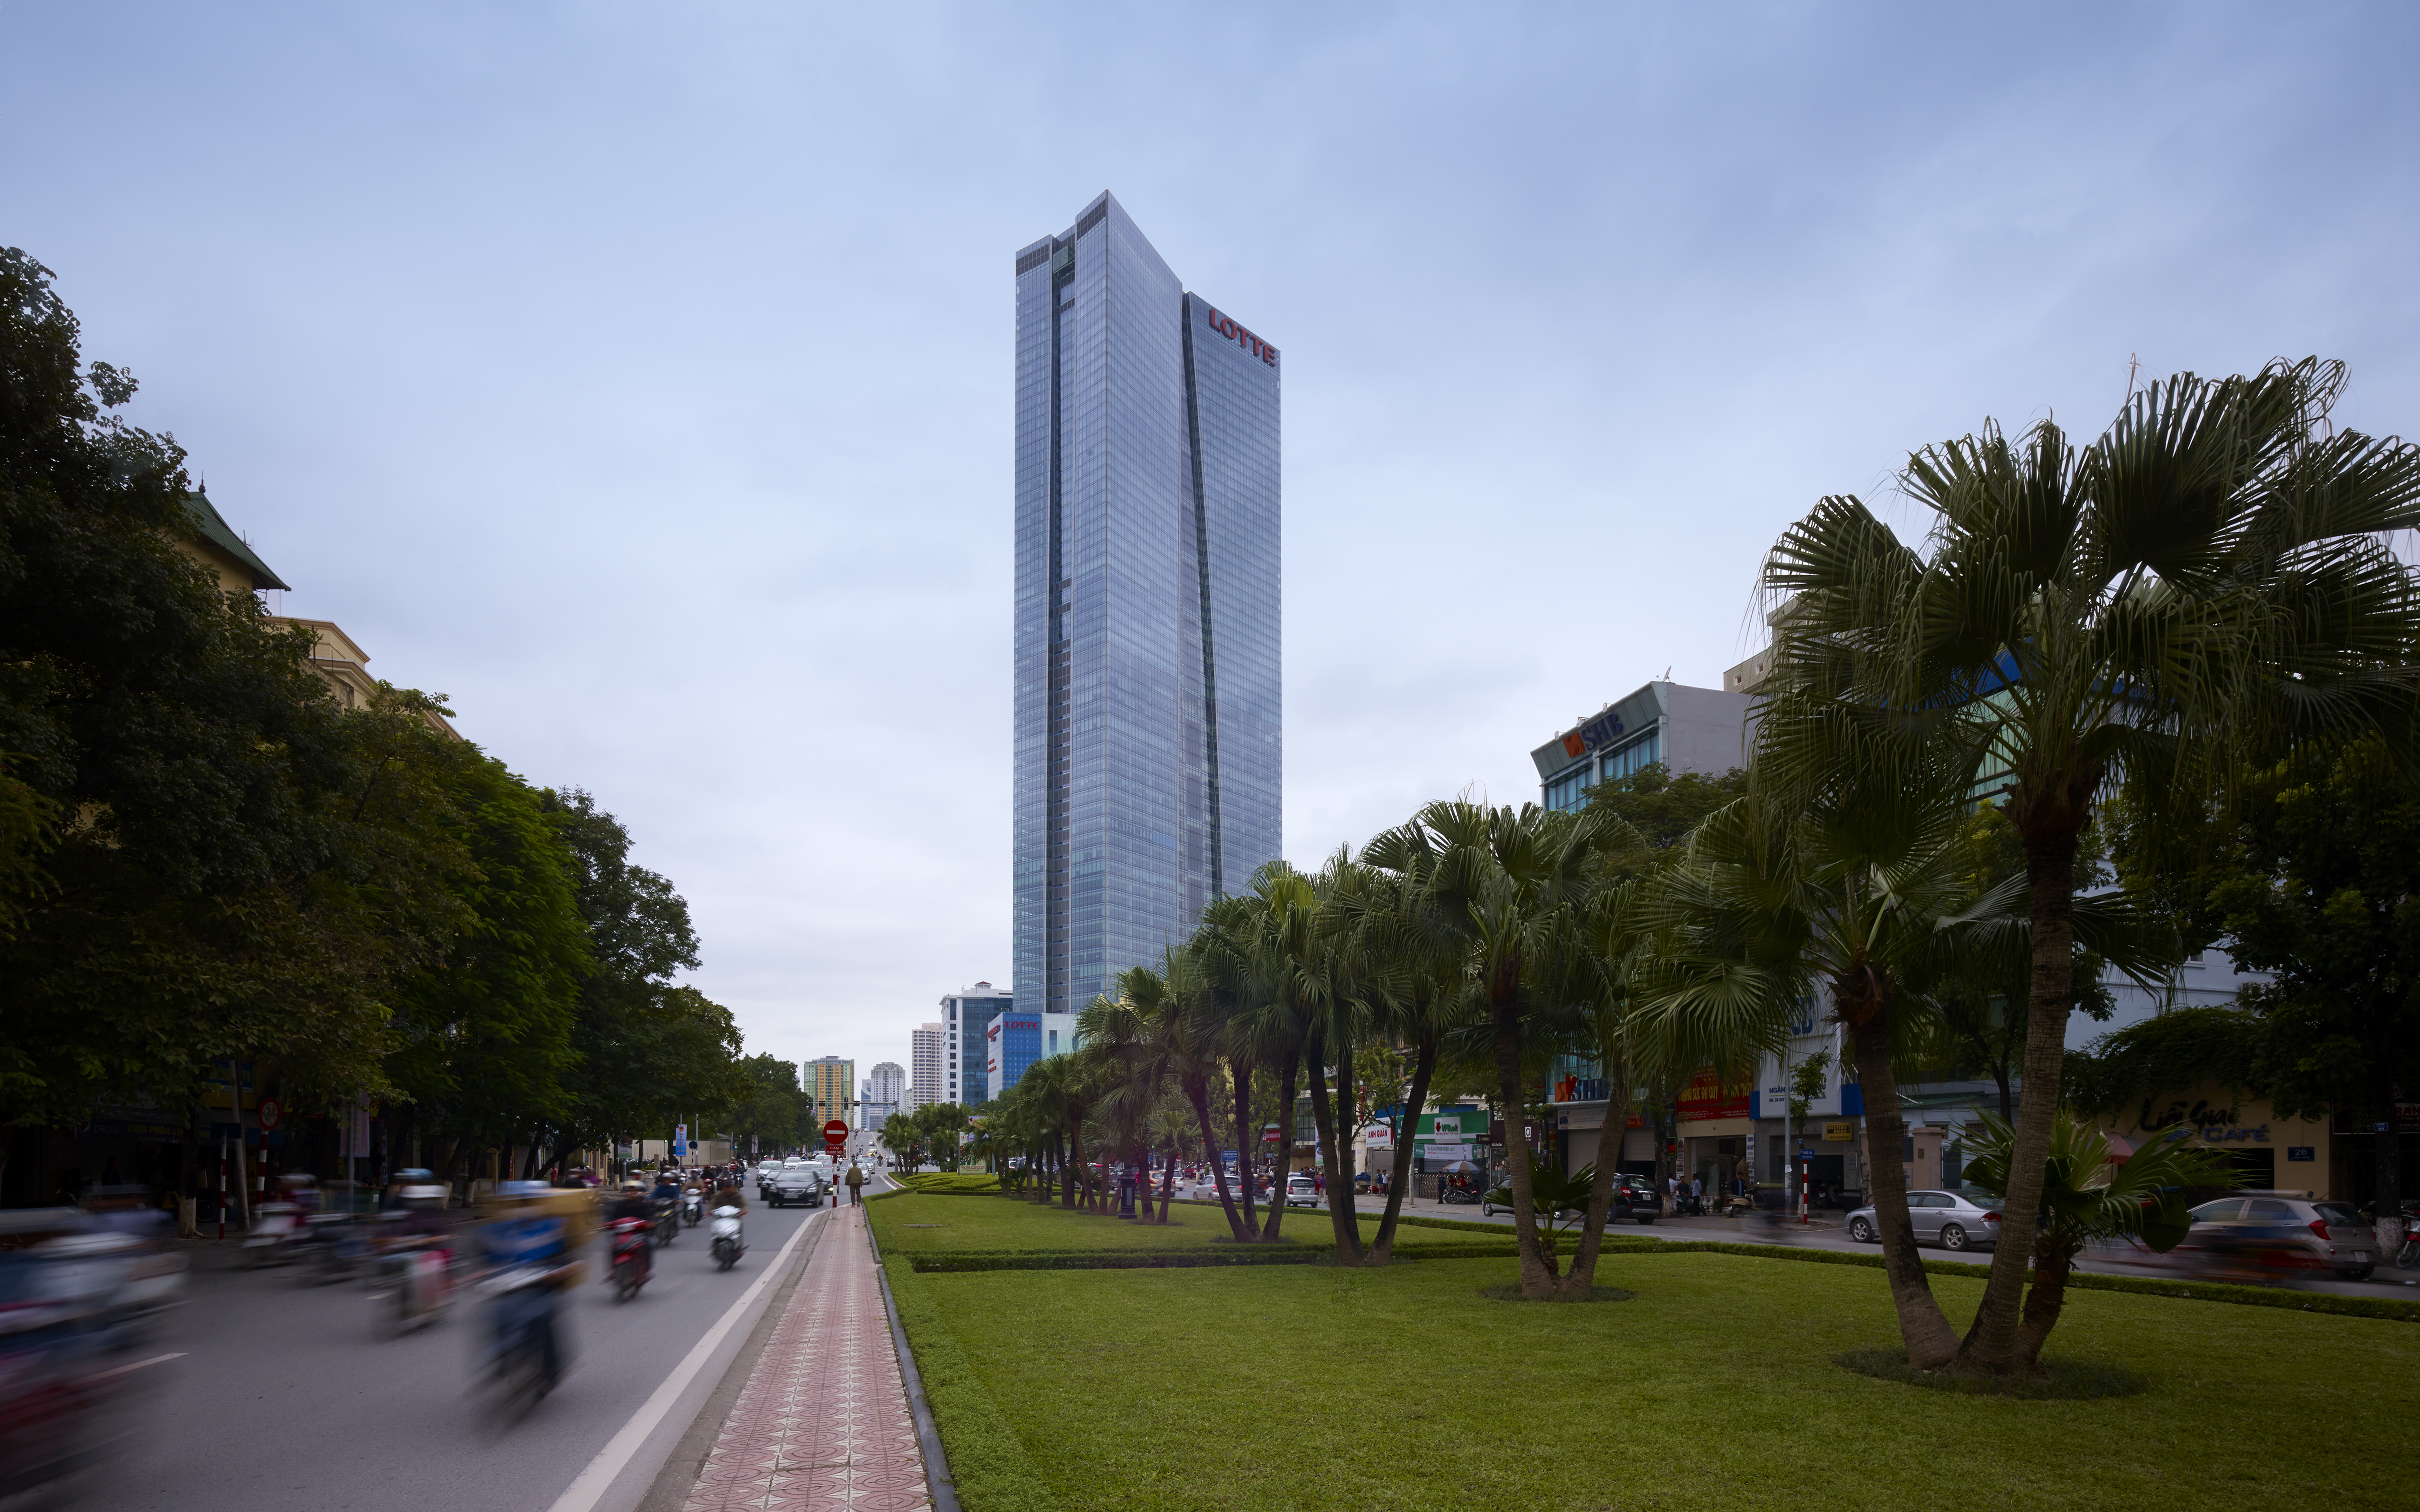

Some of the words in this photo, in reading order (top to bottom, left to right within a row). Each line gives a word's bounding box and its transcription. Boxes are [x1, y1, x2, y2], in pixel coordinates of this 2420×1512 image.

[1209, 308, 1276, 367] LOTTE
[1581, 713, 1623, 751] SHB
[1769, 1086, 1785, 1094] NGÂN
[93, 1124, 119, 1134] pepsi
[1368, 1130, 1376, 1139] ANH
[1377, 1128, 1387, 1138] QUÂN
[1442, 1124, 1458, 1132] VPBank
[2204, 1124, 2270, 1142] CAFÉ
